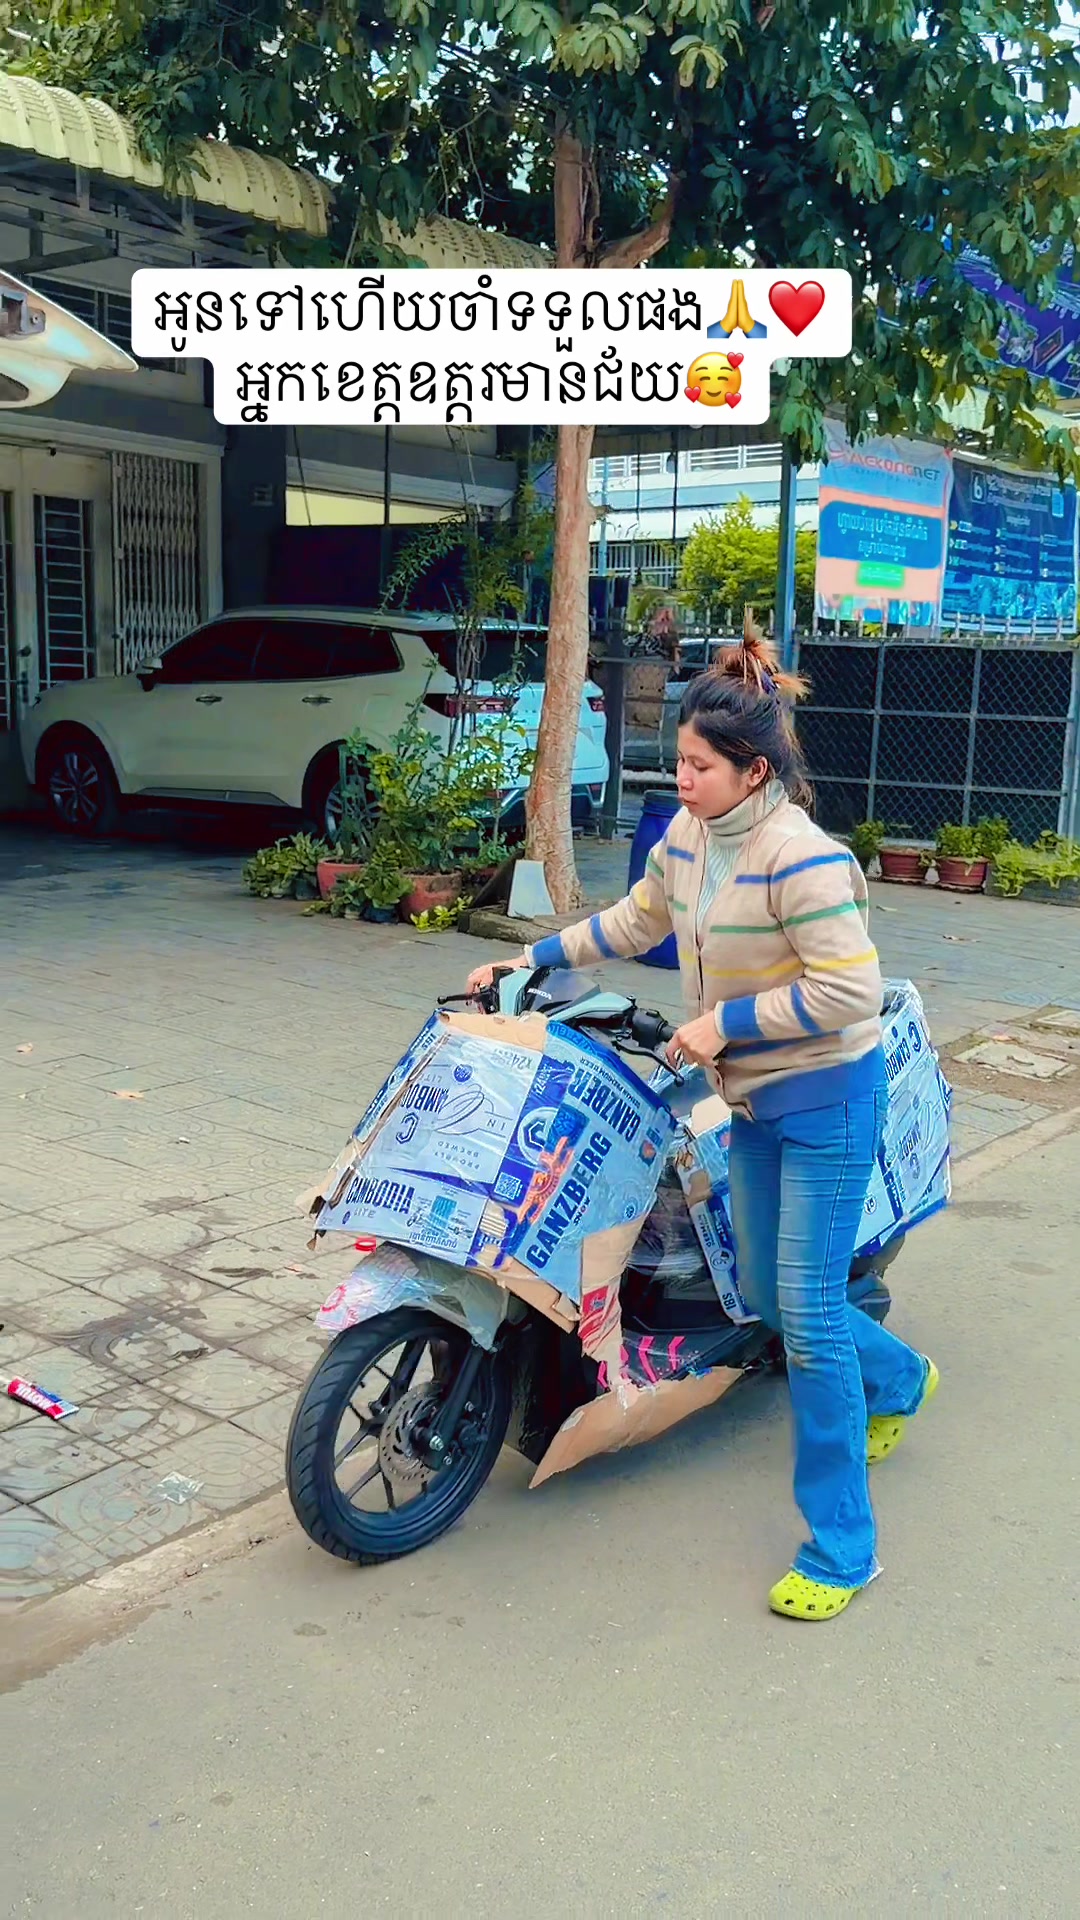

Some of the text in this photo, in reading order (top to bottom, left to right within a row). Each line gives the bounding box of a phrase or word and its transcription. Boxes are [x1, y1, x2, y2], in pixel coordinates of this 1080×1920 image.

[527, 987, 552, 1000] HONDA
[438, 1141, 479, 1158] BREWED
[345, 1176, 415, 1215] CAMBODIA
[526, 1132, 612, 1269] GANZBERG
[353, 1207, 376, 1219] LITE
[573, 1197, 590, 1226] SNOW
